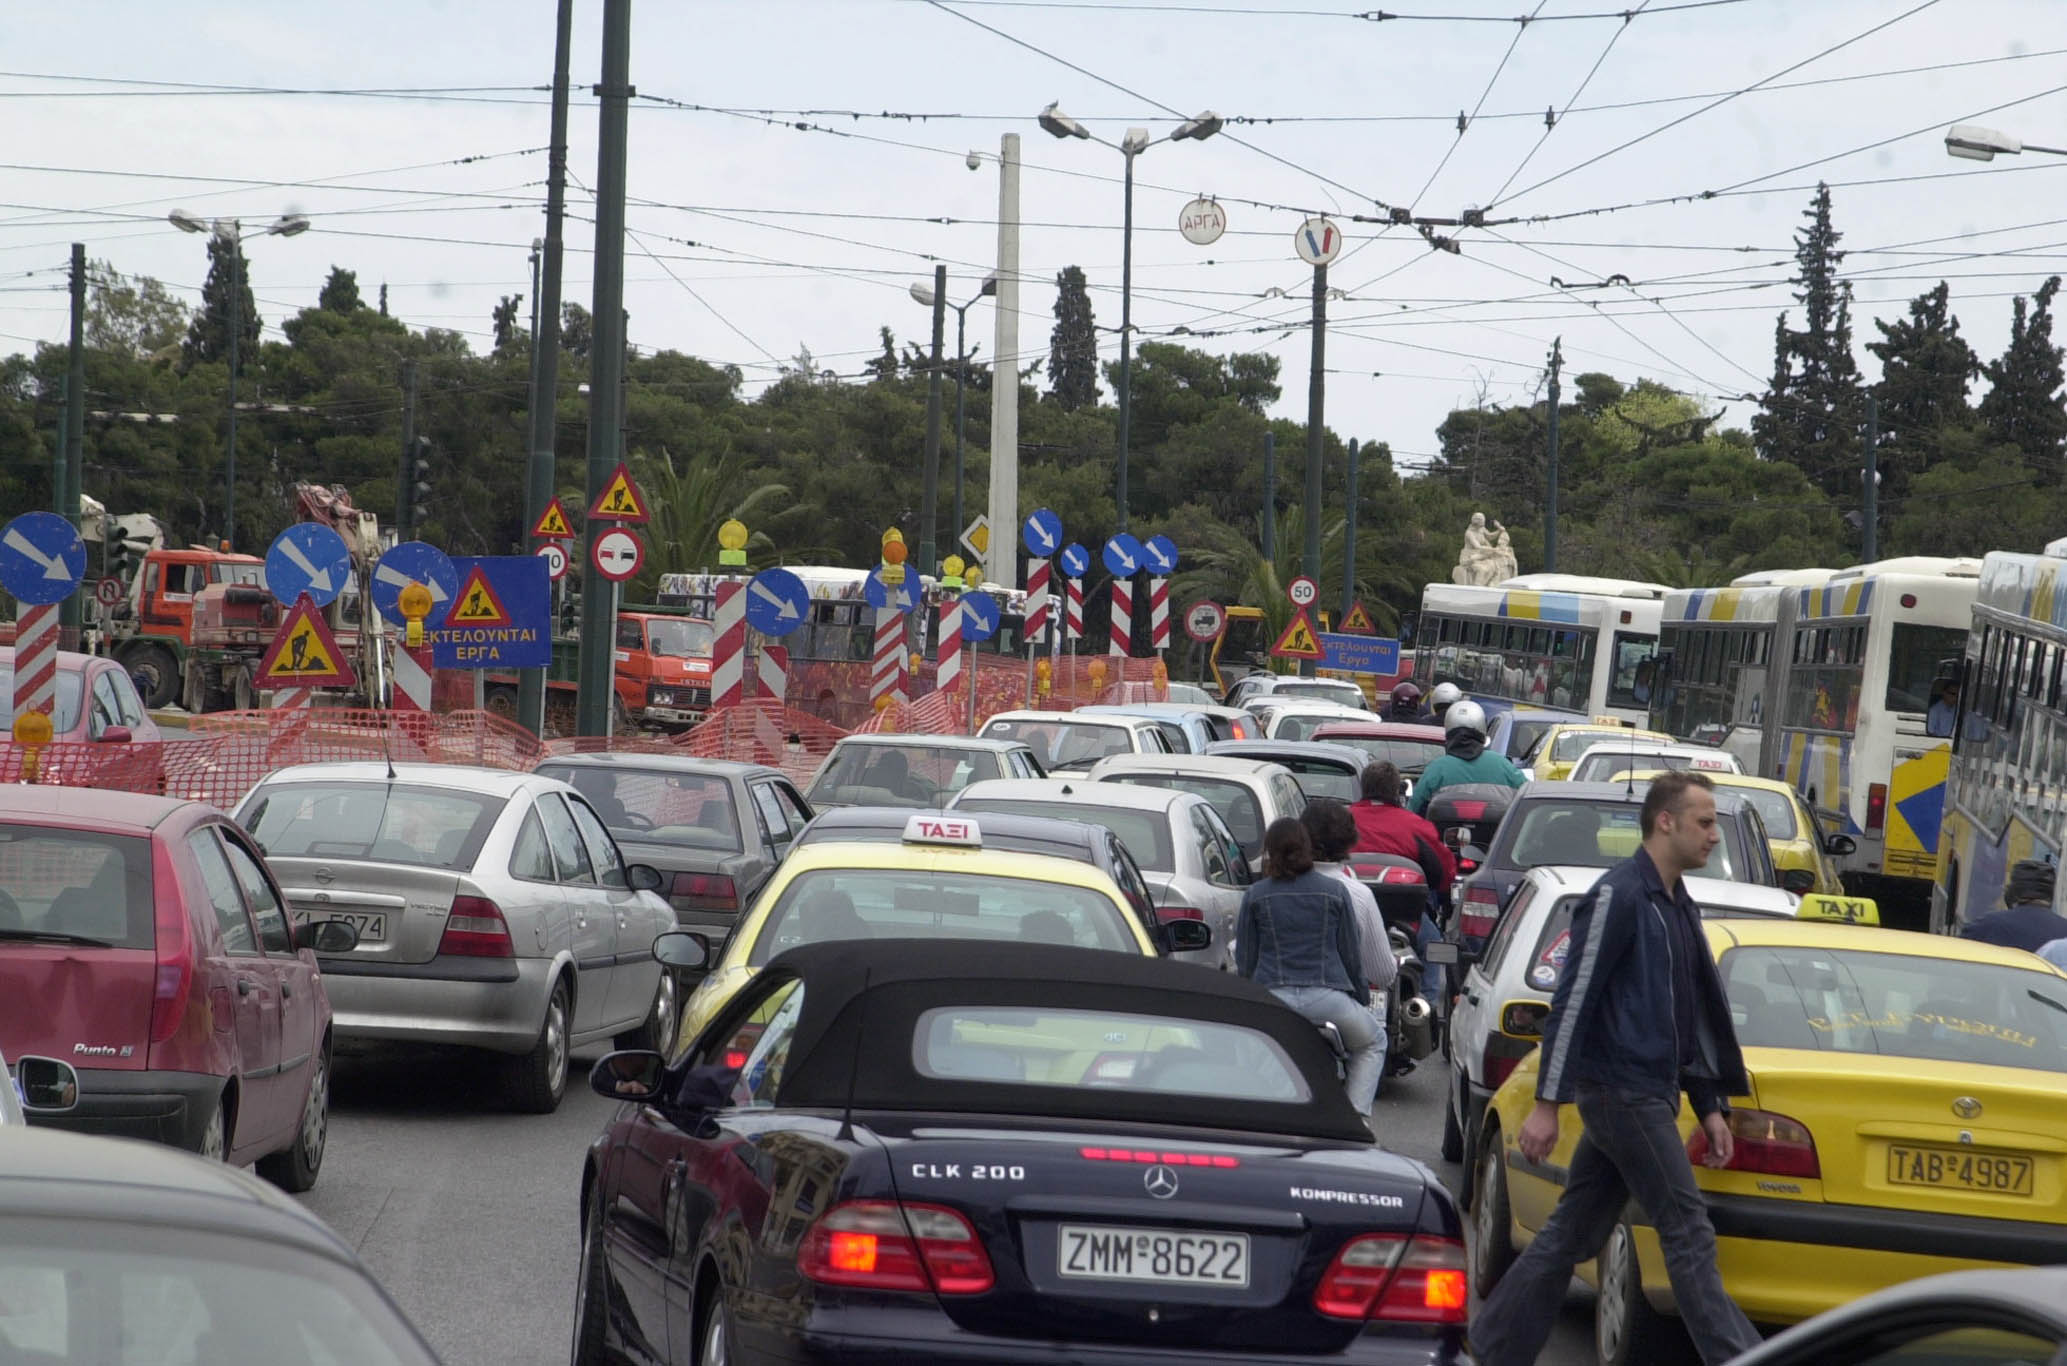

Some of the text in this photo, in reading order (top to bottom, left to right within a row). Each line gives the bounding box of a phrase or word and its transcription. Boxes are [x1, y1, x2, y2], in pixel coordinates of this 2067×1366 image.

[1184, 213, 1220, 230] ΑΡΓΑ
[1294, 586, 1312, 598] 50
[456, 646, 500, 661] ΕΡΓΑ
[917, 822, 969, 839] ΤΑΞΙ
[1816, 899, 1865, 918] TAXI
[73, 1042, 117, 1057] Punto
[912, 1163, 1025, 1180] CLK 200
[1290, 1186, 1404, 1209] KOMPRESSOR
